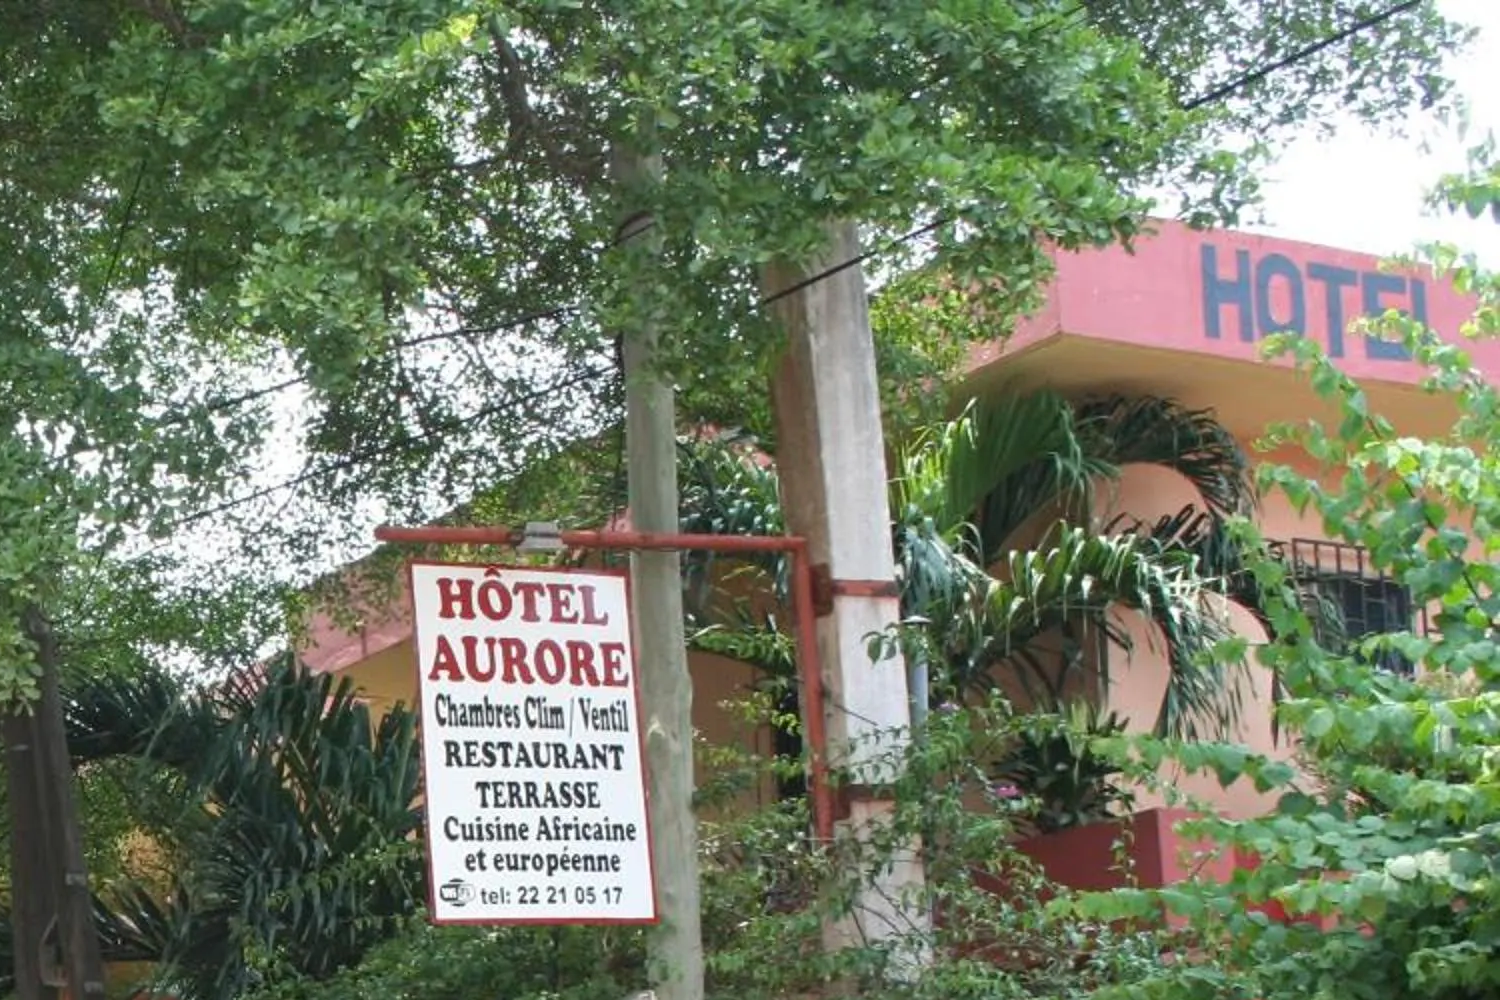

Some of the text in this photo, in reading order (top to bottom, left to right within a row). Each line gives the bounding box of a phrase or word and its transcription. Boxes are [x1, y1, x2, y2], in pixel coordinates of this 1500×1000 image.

[436, 566, 609, 626] HÔTEL
[428, 634, 629, 687] AURORE
[434, 692, 630, 738] Chambres Clim / Ventil
[443, 739, 625, 771] RESTAURANT
[475, 780, 602, 809] TERRASSE
[443, 815, 637, 842] Cuisine Africaine
[465, 846, 621, 876] et européenne
[480, 885, 623, 905] tel: 22 21 05 17
